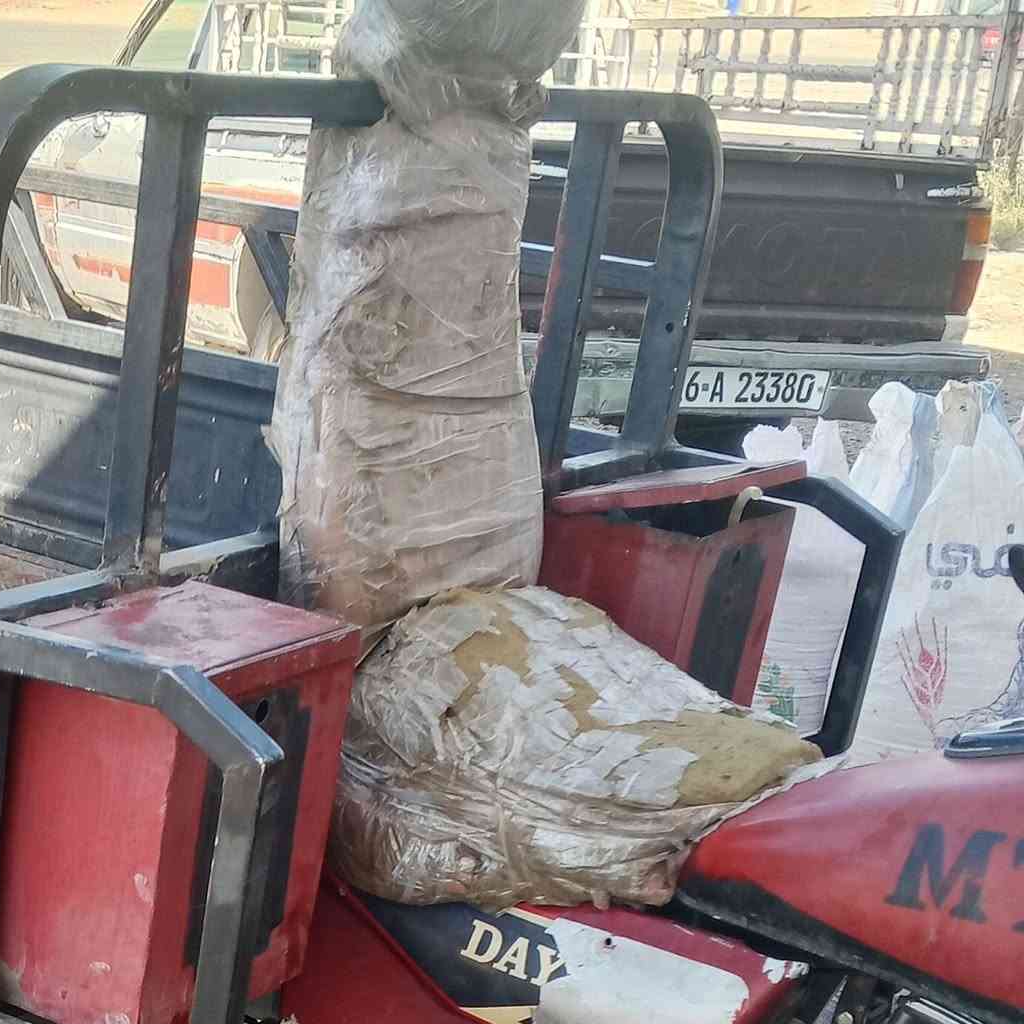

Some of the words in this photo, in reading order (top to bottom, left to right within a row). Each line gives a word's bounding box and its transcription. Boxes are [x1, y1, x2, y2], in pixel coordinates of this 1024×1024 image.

[734, 372, 816, 403] 23380
[882, 822, 1024, 932] M
[460, 918, 568, 986] DAY
